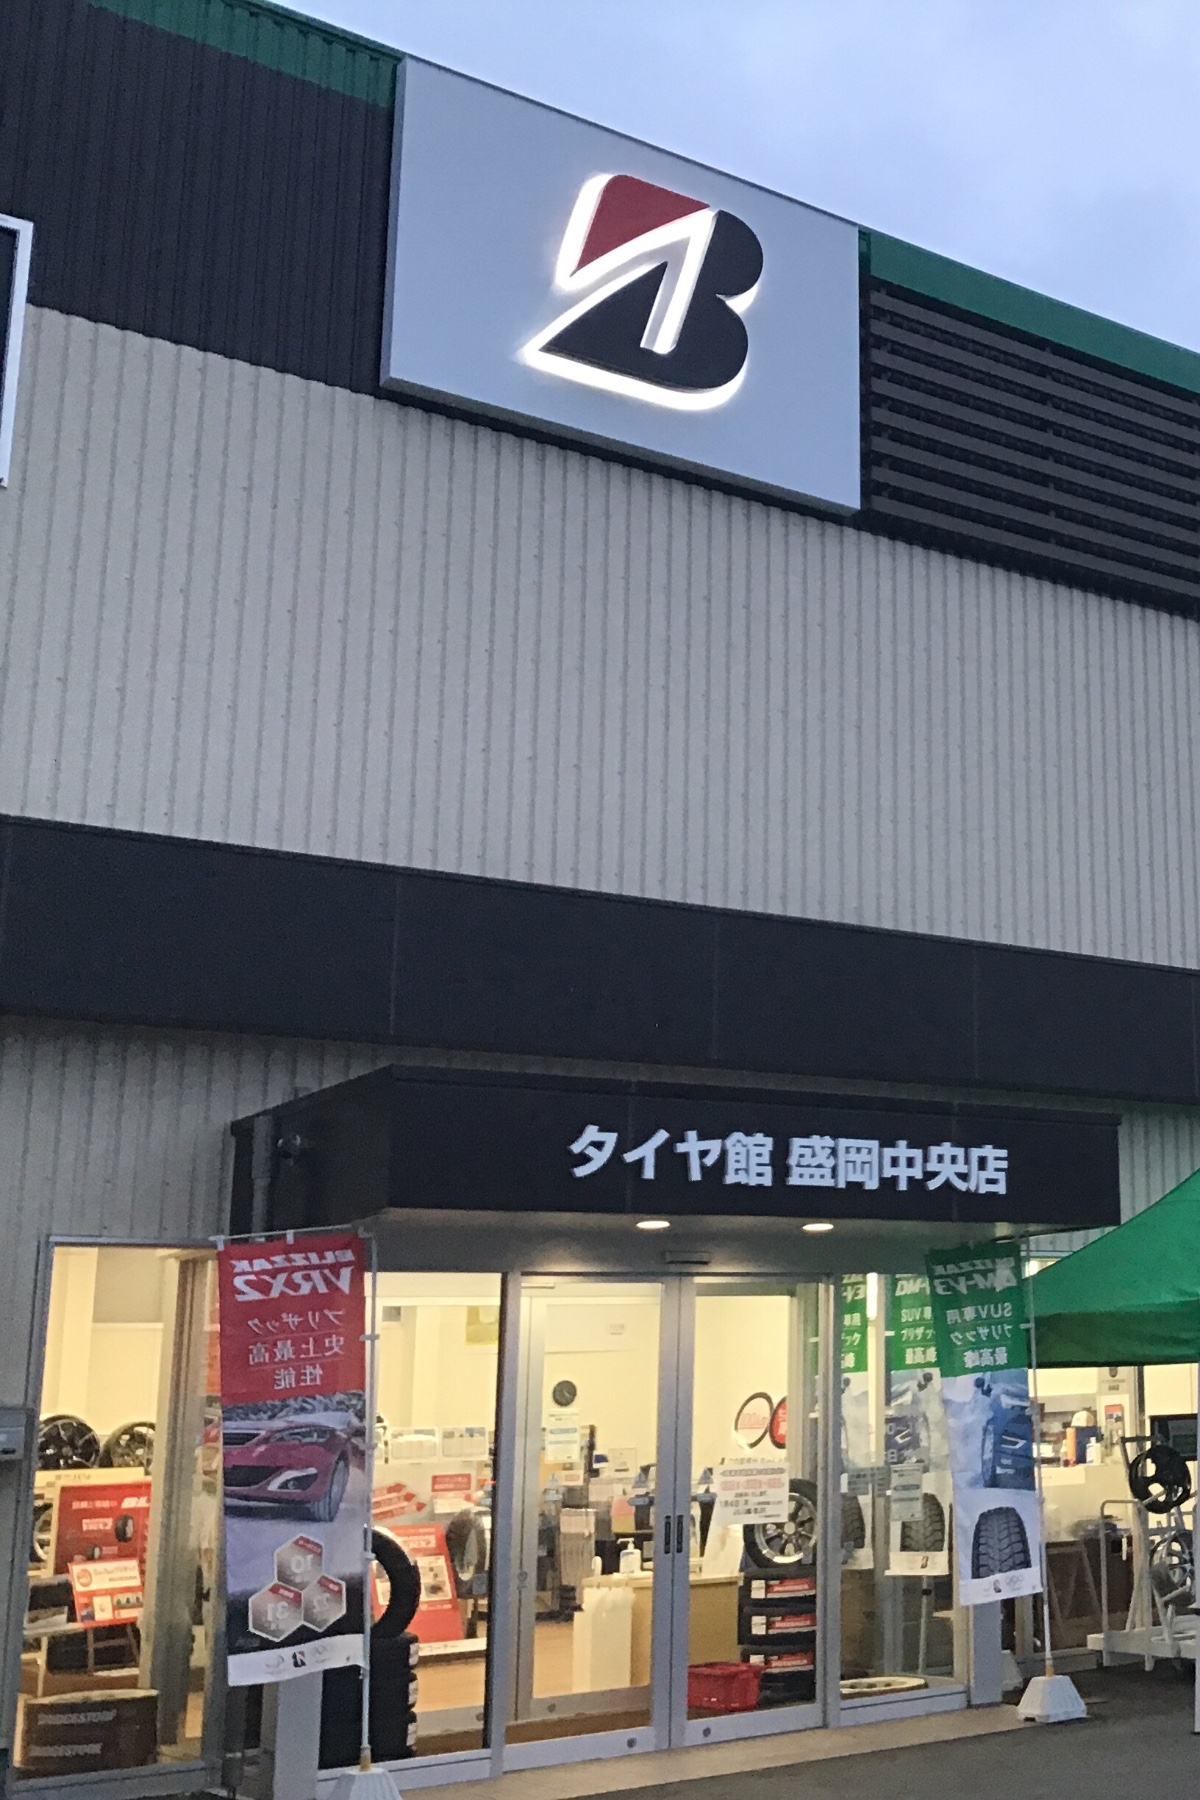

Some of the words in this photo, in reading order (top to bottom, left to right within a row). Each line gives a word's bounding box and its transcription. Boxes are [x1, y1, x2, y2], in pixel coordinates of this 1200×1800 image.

[569, 1125, 774, 1187] タイヤ館
[786, 1136, 1009, 1195] 盛岡中央店
